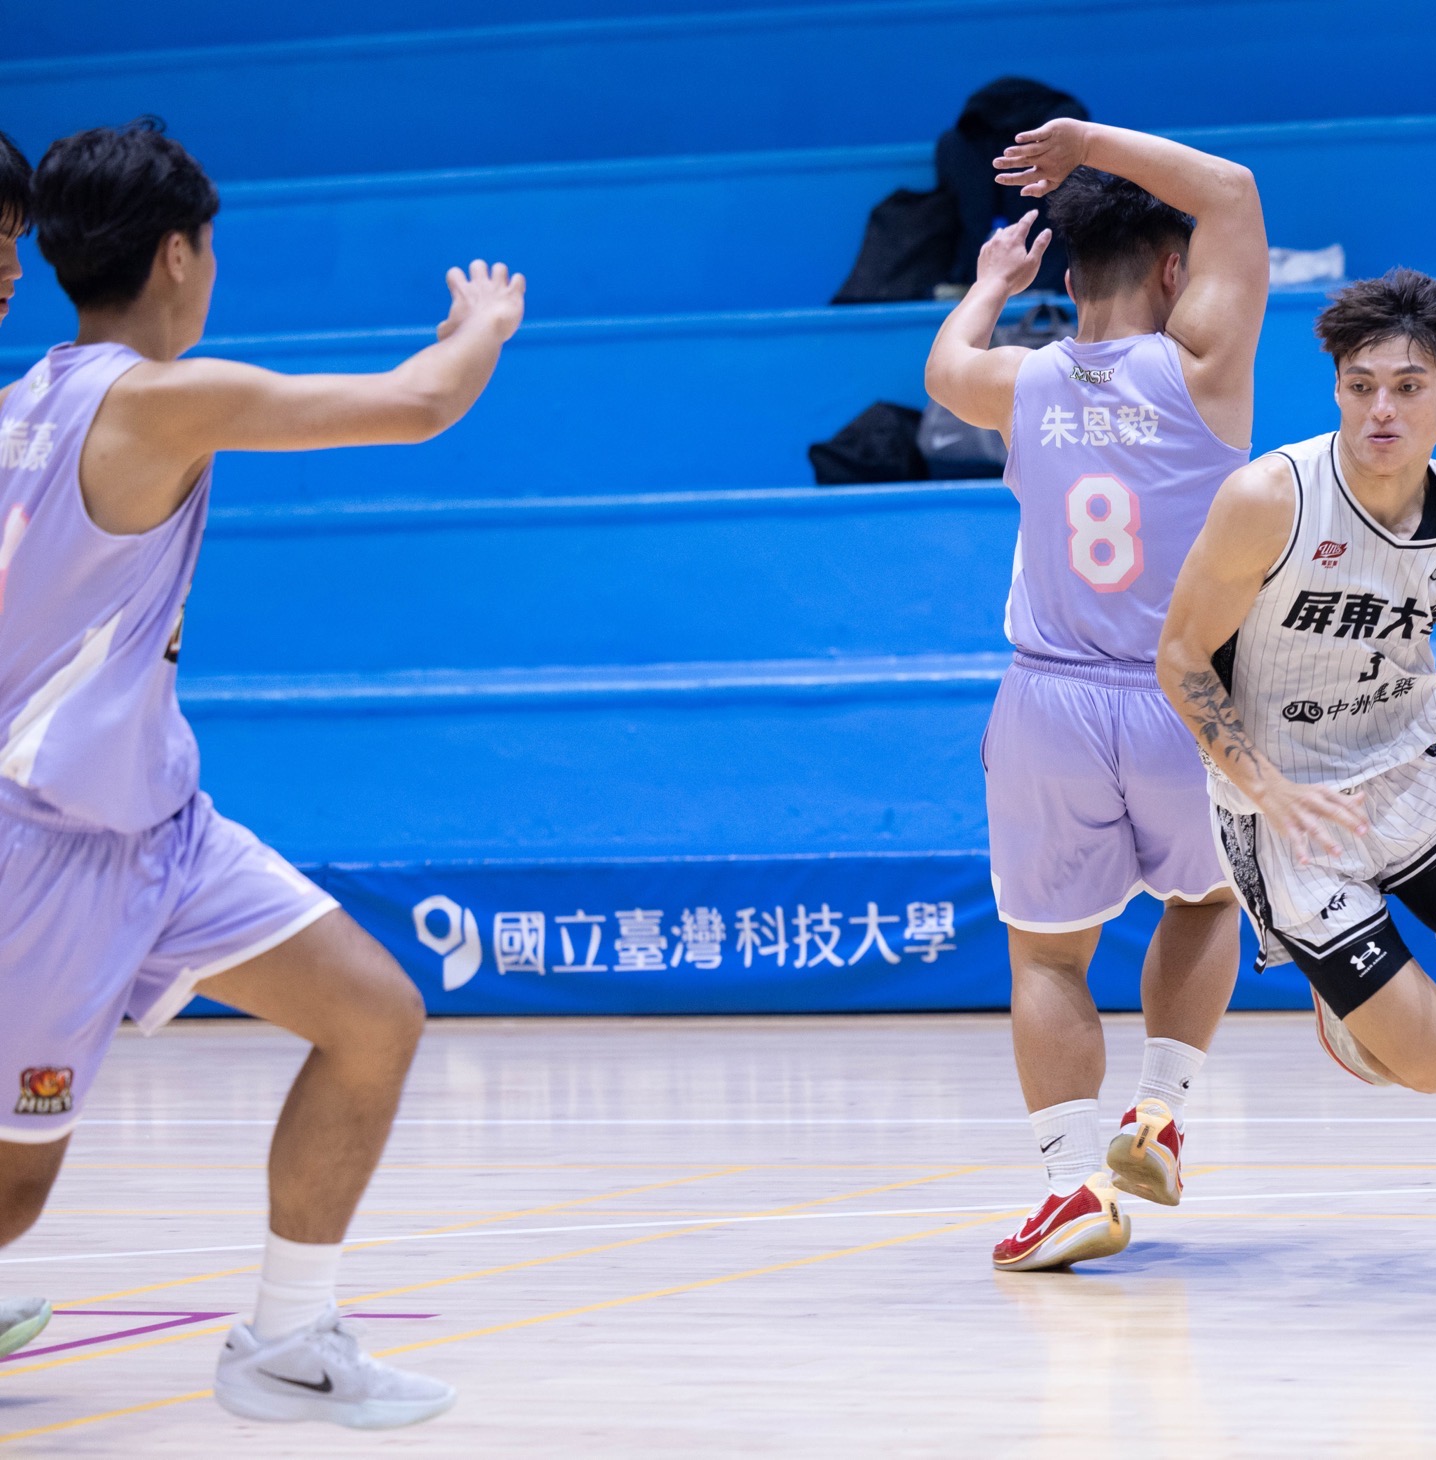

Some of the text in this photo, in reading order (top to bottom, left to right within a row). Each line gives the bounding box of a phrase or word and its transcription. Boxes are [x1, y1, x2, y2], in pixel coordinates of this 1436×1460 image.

[1040, 404, 1163, 449] 朱恩毅
[1065, 473, 1144, 593] 8
[493, 901, 957, 976] 國立臺灣科技大學
